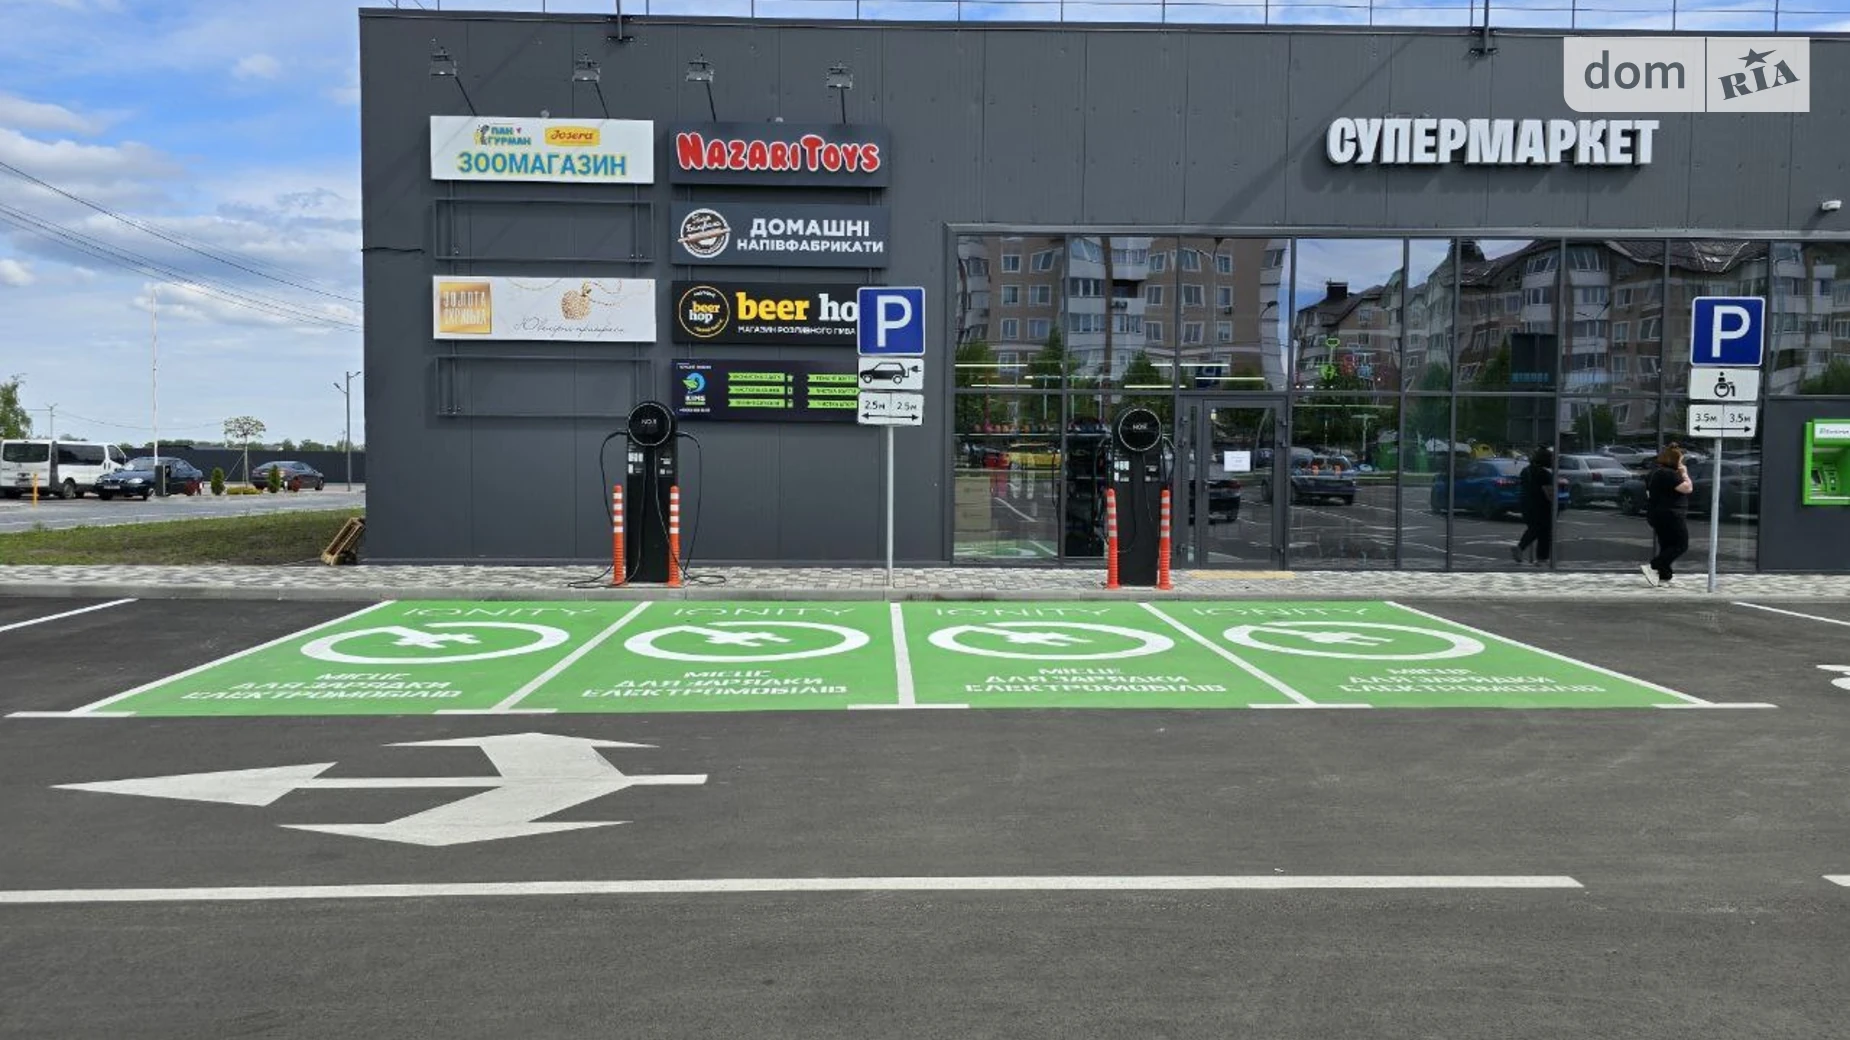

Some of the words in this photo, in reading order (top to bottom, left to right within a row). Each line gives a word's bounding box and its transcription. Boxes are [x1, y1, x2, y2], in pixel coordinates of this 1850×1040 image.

[550, 128, 593, 141] Josera
[1326, 117, 1659, 166] СУПЕРМАРКЕТ
[488, 137, 532, 147] ГУРМАН
[456, 152, 627, 176] ЗООМАГАЗИН
[749, 218, 870, 237] ДОМАШНІ
[737, 239, 884, 253] НАПІВФАБРИКАТИ
[692, 301, 720, 313] beer
[736, 292, 810, 321] beer
[818, 293, 858, 322] ho
[689, 309, 713, 324] hop
[877, 295, 912, 347] P
[738, 326, 776, 334] МАГАЗИН
[1711, 305, 1750, 358] P
[402, 608, 595, 616] IONITY
[672, 607, 855, 616] IONITY
[935, 607, 1111, 616] IONITY
